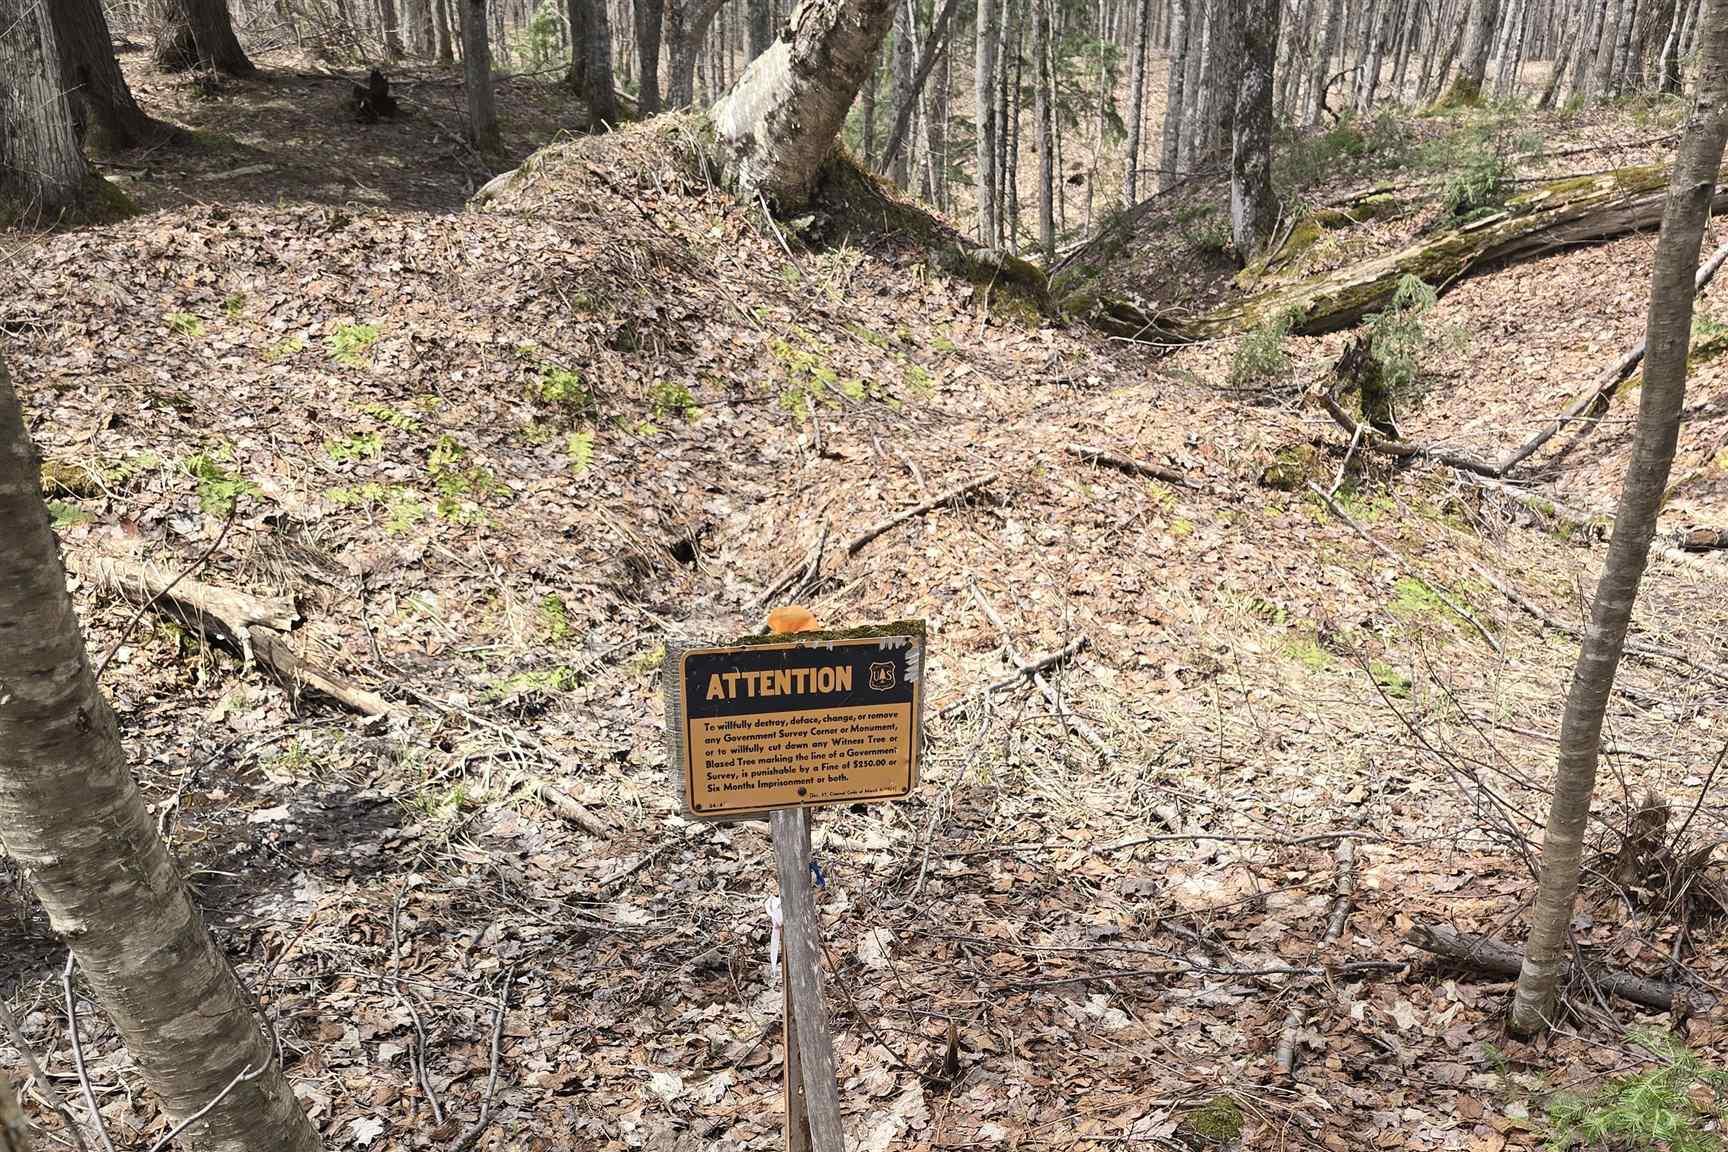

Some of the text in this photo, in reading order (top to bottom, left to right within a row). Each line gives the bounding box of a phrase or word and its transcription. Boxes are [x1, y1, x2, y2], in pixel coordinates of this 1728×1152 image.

[706, 666, 852, 700] ATTENTION
[704, 723, 715, 731] To
[717, 720, 752, 730] willfully
[754, 719, 788, 728] destroy,
[790, 716, 821, 725] deface,
[823, 714, 856, 723] change,
[724, 732, 776, 742] Government
[779, 729, 807, 738] Survey
[811, 727, 837, 735] Corner
[850, 724, 898, 732] Monument,
[730, 744, 764, 753] willfully
[832, 738, 864, 746] Witness
[737, 757, 755, 766] Tree
[759, 754, 793, 764] marking
[811, 752, 825, 760] line
[847, 747, 897, 757] Government
[706, 772, 738, 781] Survey,
[751, 766, 796, 778] punishable
[800, 765, 809, 774] by
[854, 759, 886, 768] $250.00
[707, 784, 720, 792] Six
[724, 781, 754, 791] Months
[758, 778, 813, 788] Imprisonment
[828, 774, 848, 782] both.
